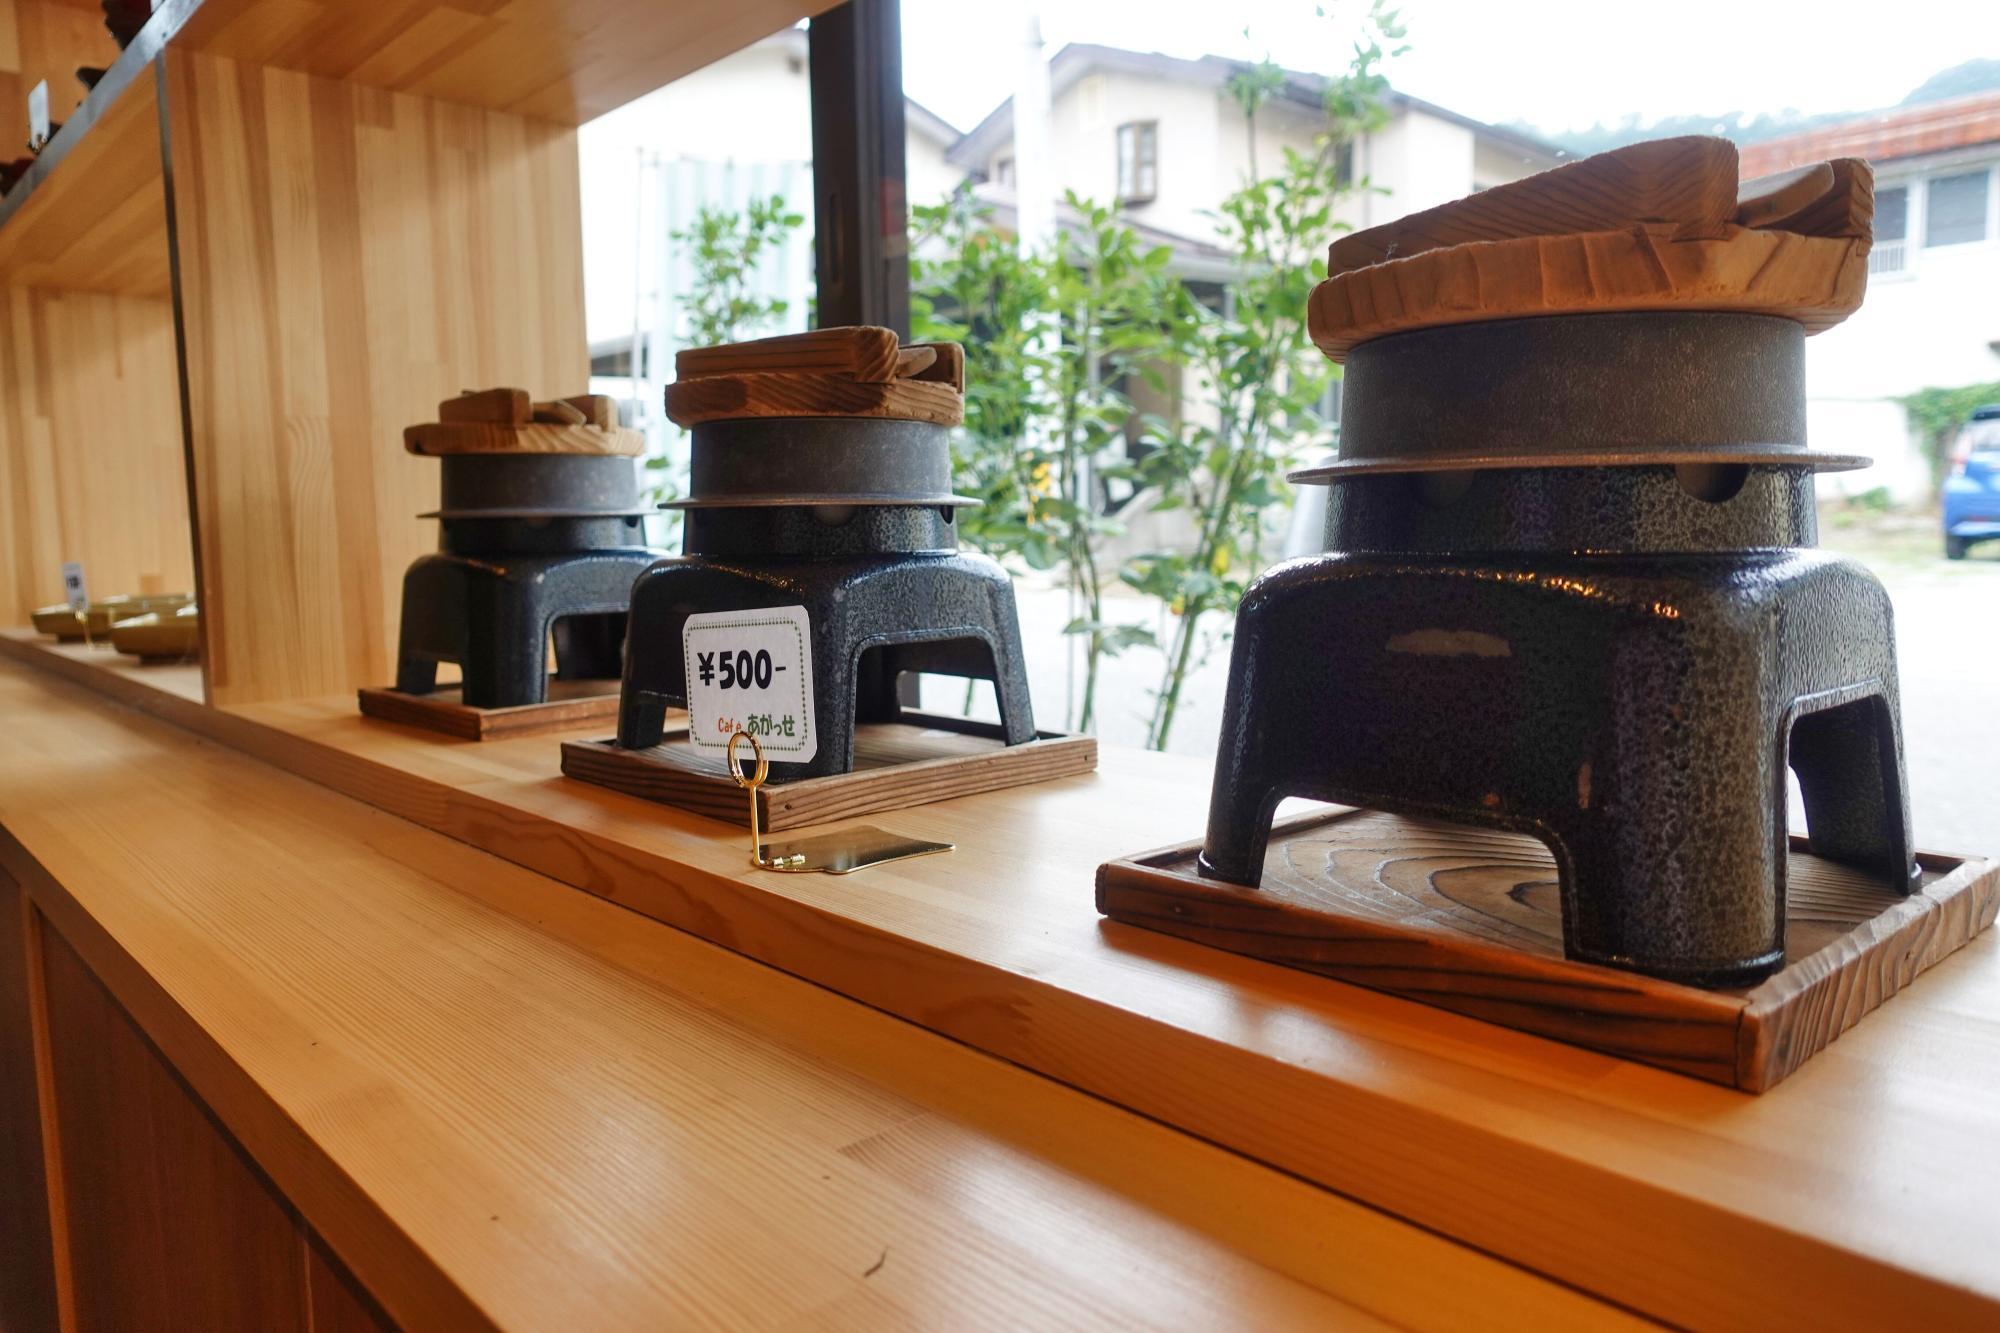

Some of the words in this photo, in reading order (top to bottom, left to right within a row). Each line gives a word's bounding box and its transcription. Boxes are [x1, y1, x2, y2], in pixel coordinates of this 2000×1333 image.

[697, 649, 786, 690] ¥500-
[747, 713, 795, 737] あがっせ
